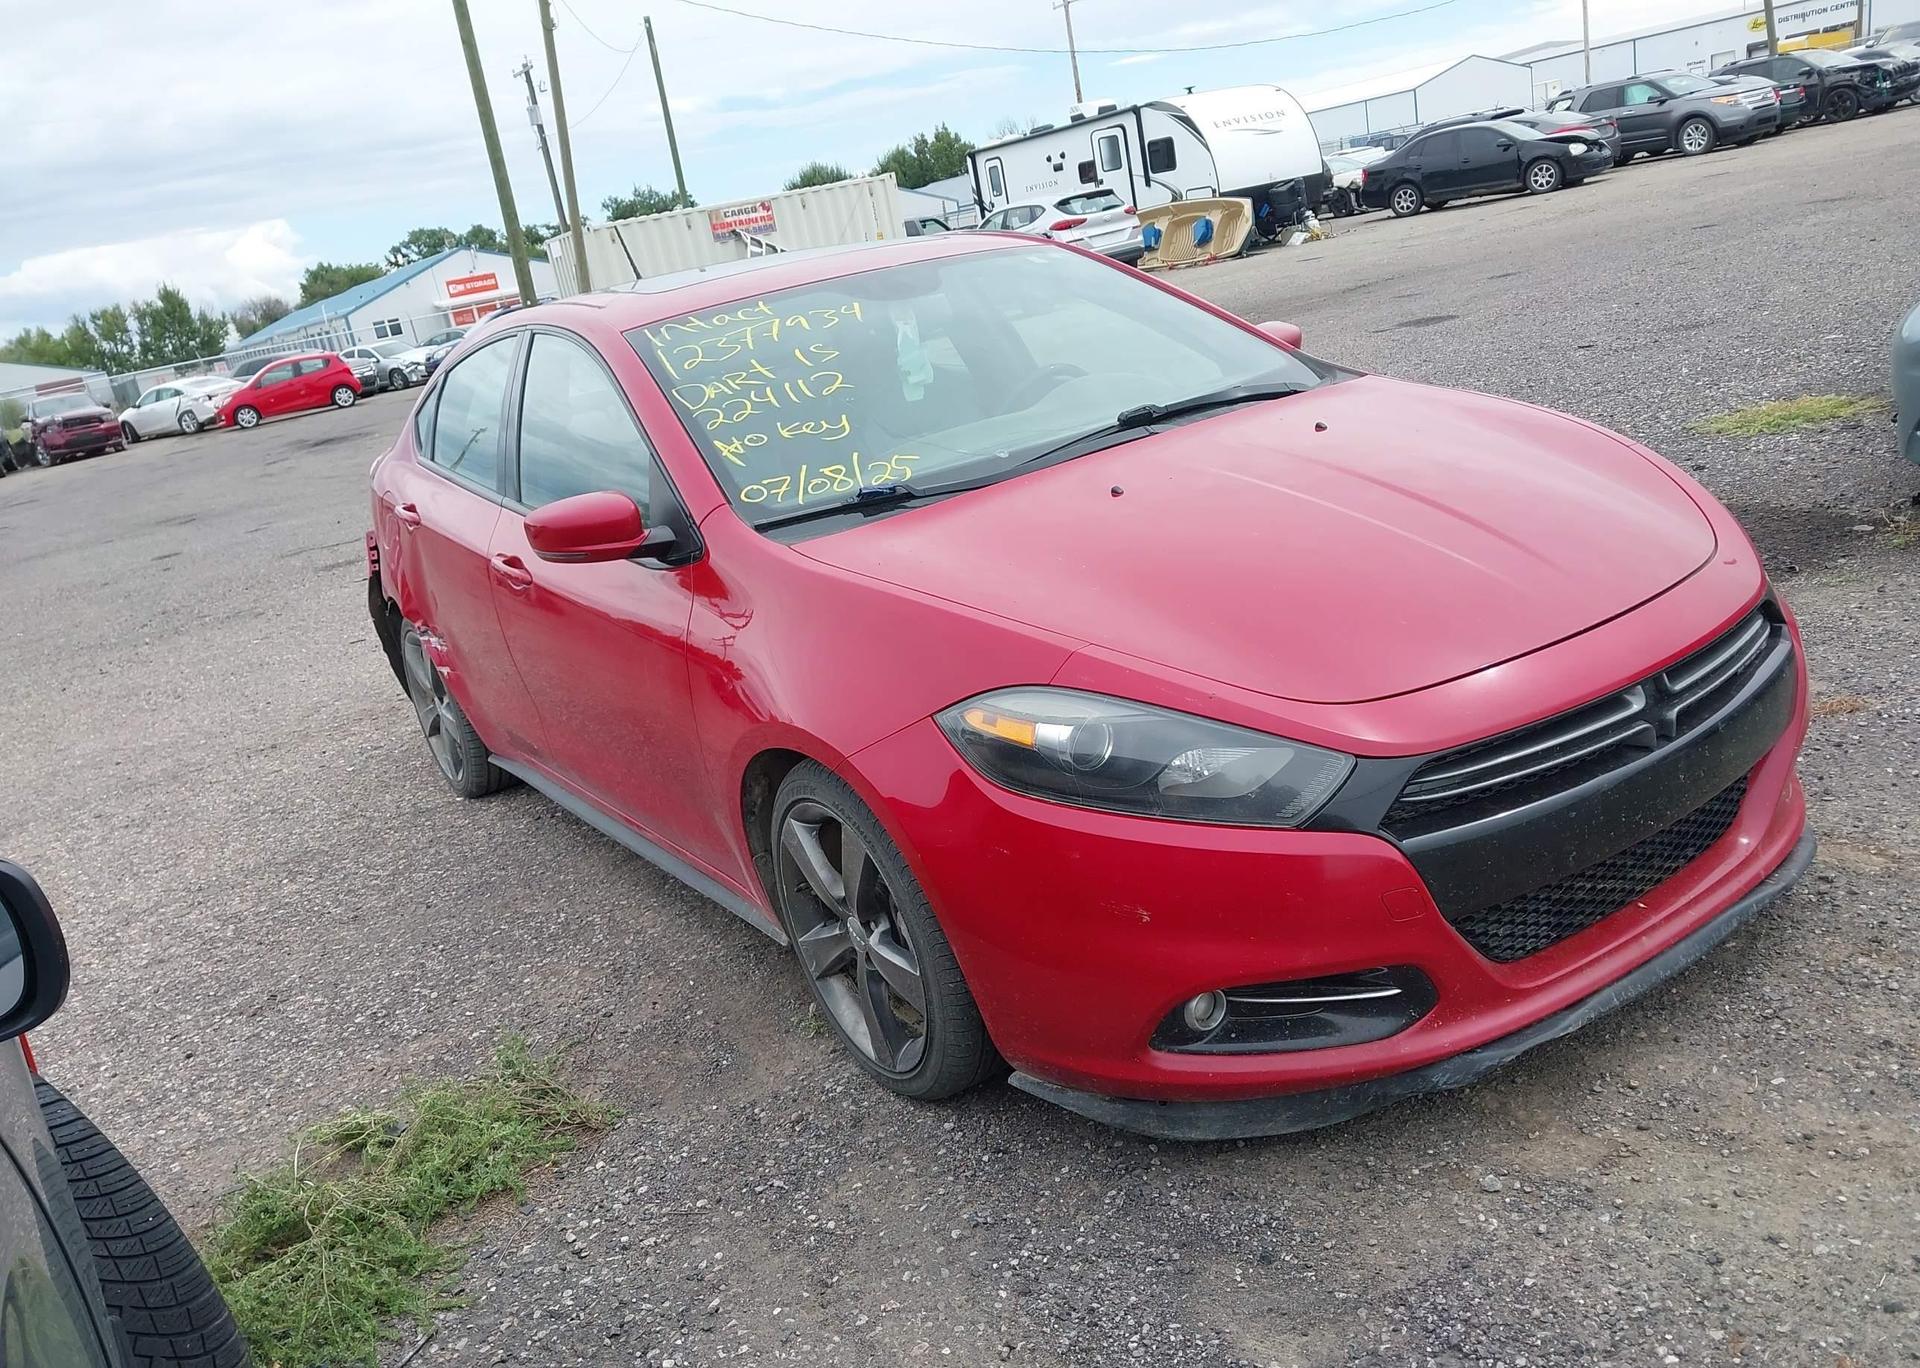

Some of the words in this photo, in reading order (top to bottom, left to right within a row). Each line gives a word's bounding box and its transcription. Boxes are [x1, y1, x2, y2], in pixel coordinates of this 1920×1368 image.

[1778, 7, 1828, 23] DISTRIBUTION
[1213, 109, 1286, 129] ENVISION
[1025, 180, 1058, 193] ENVISION
[723, 206, 757, 218] CARGO
[712, 214, 774, 231] CONTAINERS
[692, 371, 855, 430] 224112
[739, 451, 921, 505] 07/08/25
